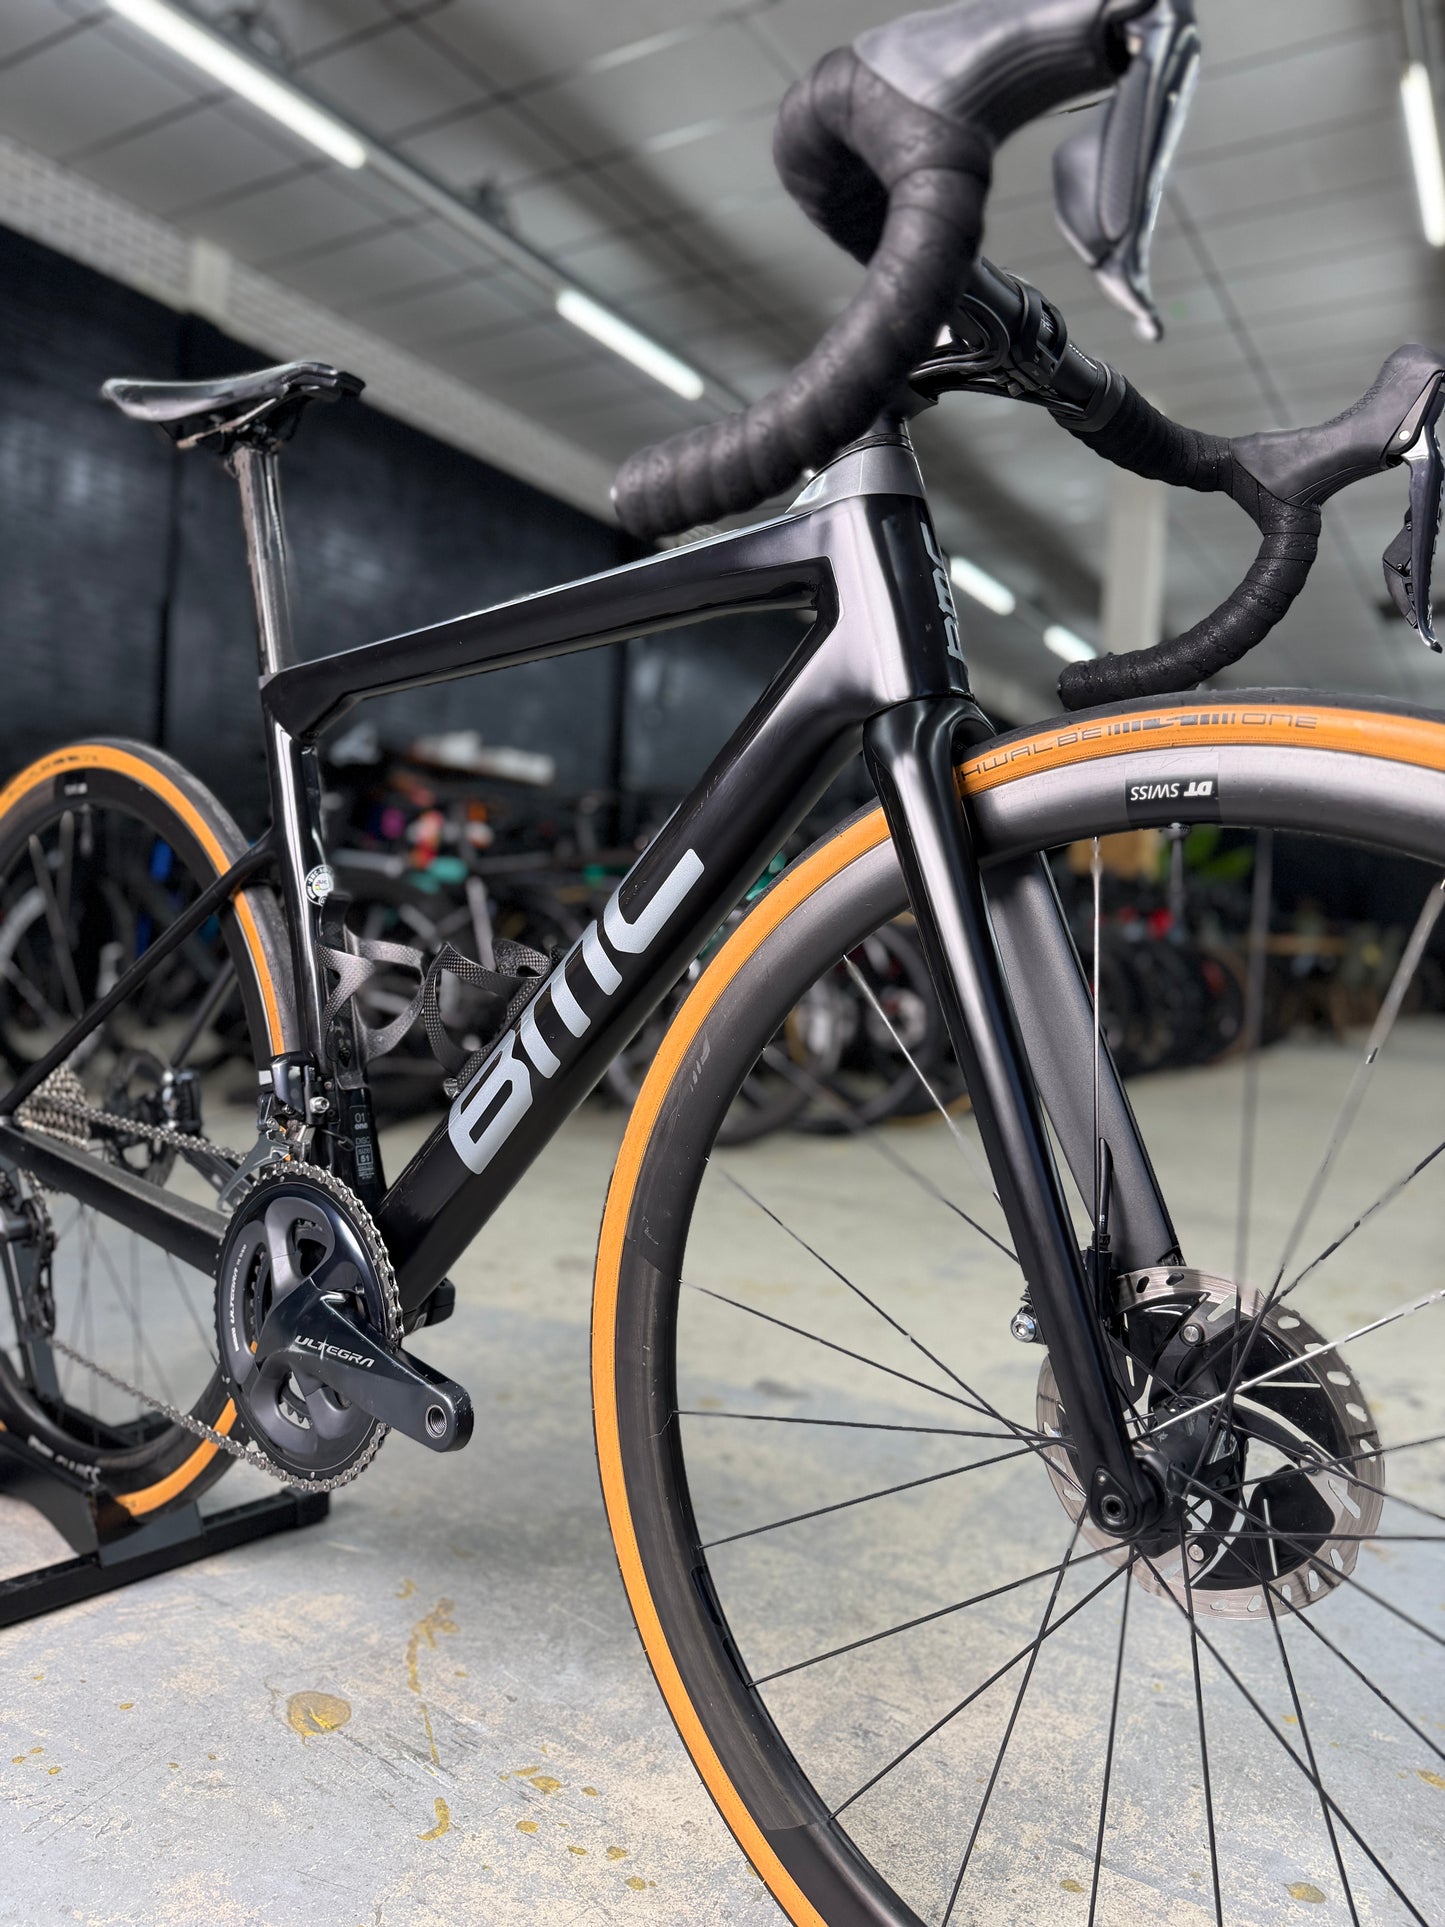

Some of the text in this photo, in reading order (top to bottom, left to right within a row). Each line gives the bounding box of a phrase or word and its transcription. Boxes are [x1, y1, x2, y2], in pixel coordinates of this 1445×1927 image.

[956, 726, 1103, 784] HWALBE
[1130, 780, 1213, 802] DT SWISS
[293, 1334, 376, 1368] ULTEGRA
